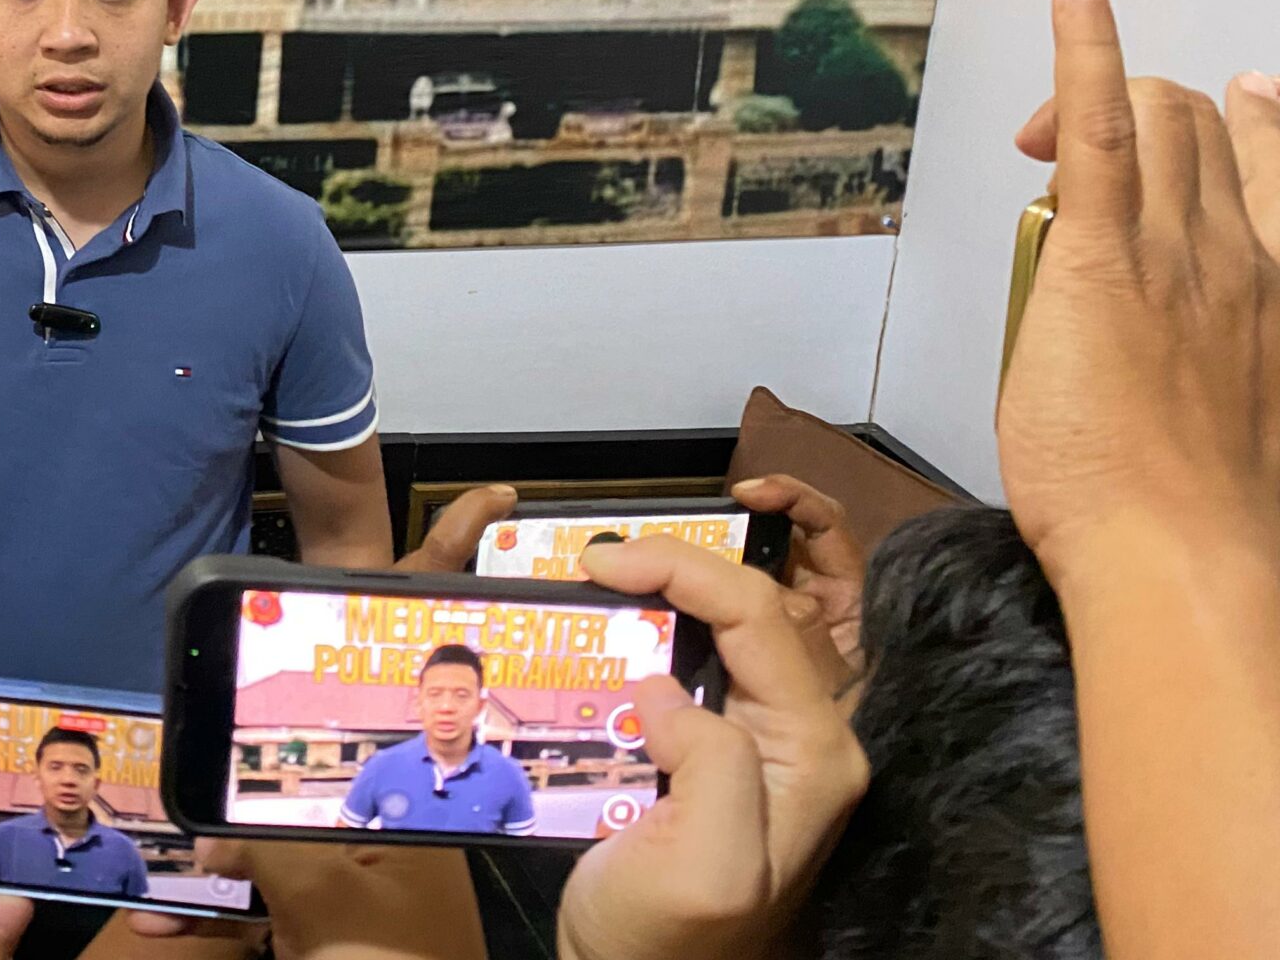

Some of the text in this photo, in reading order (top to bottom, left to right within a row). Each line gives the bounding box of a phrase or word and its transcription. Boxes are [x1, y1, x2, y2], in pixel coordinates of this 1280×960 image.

[480, 605, 610, 655] CENTER
[313, 643, 628, 692] POLRE DRAMAYU
